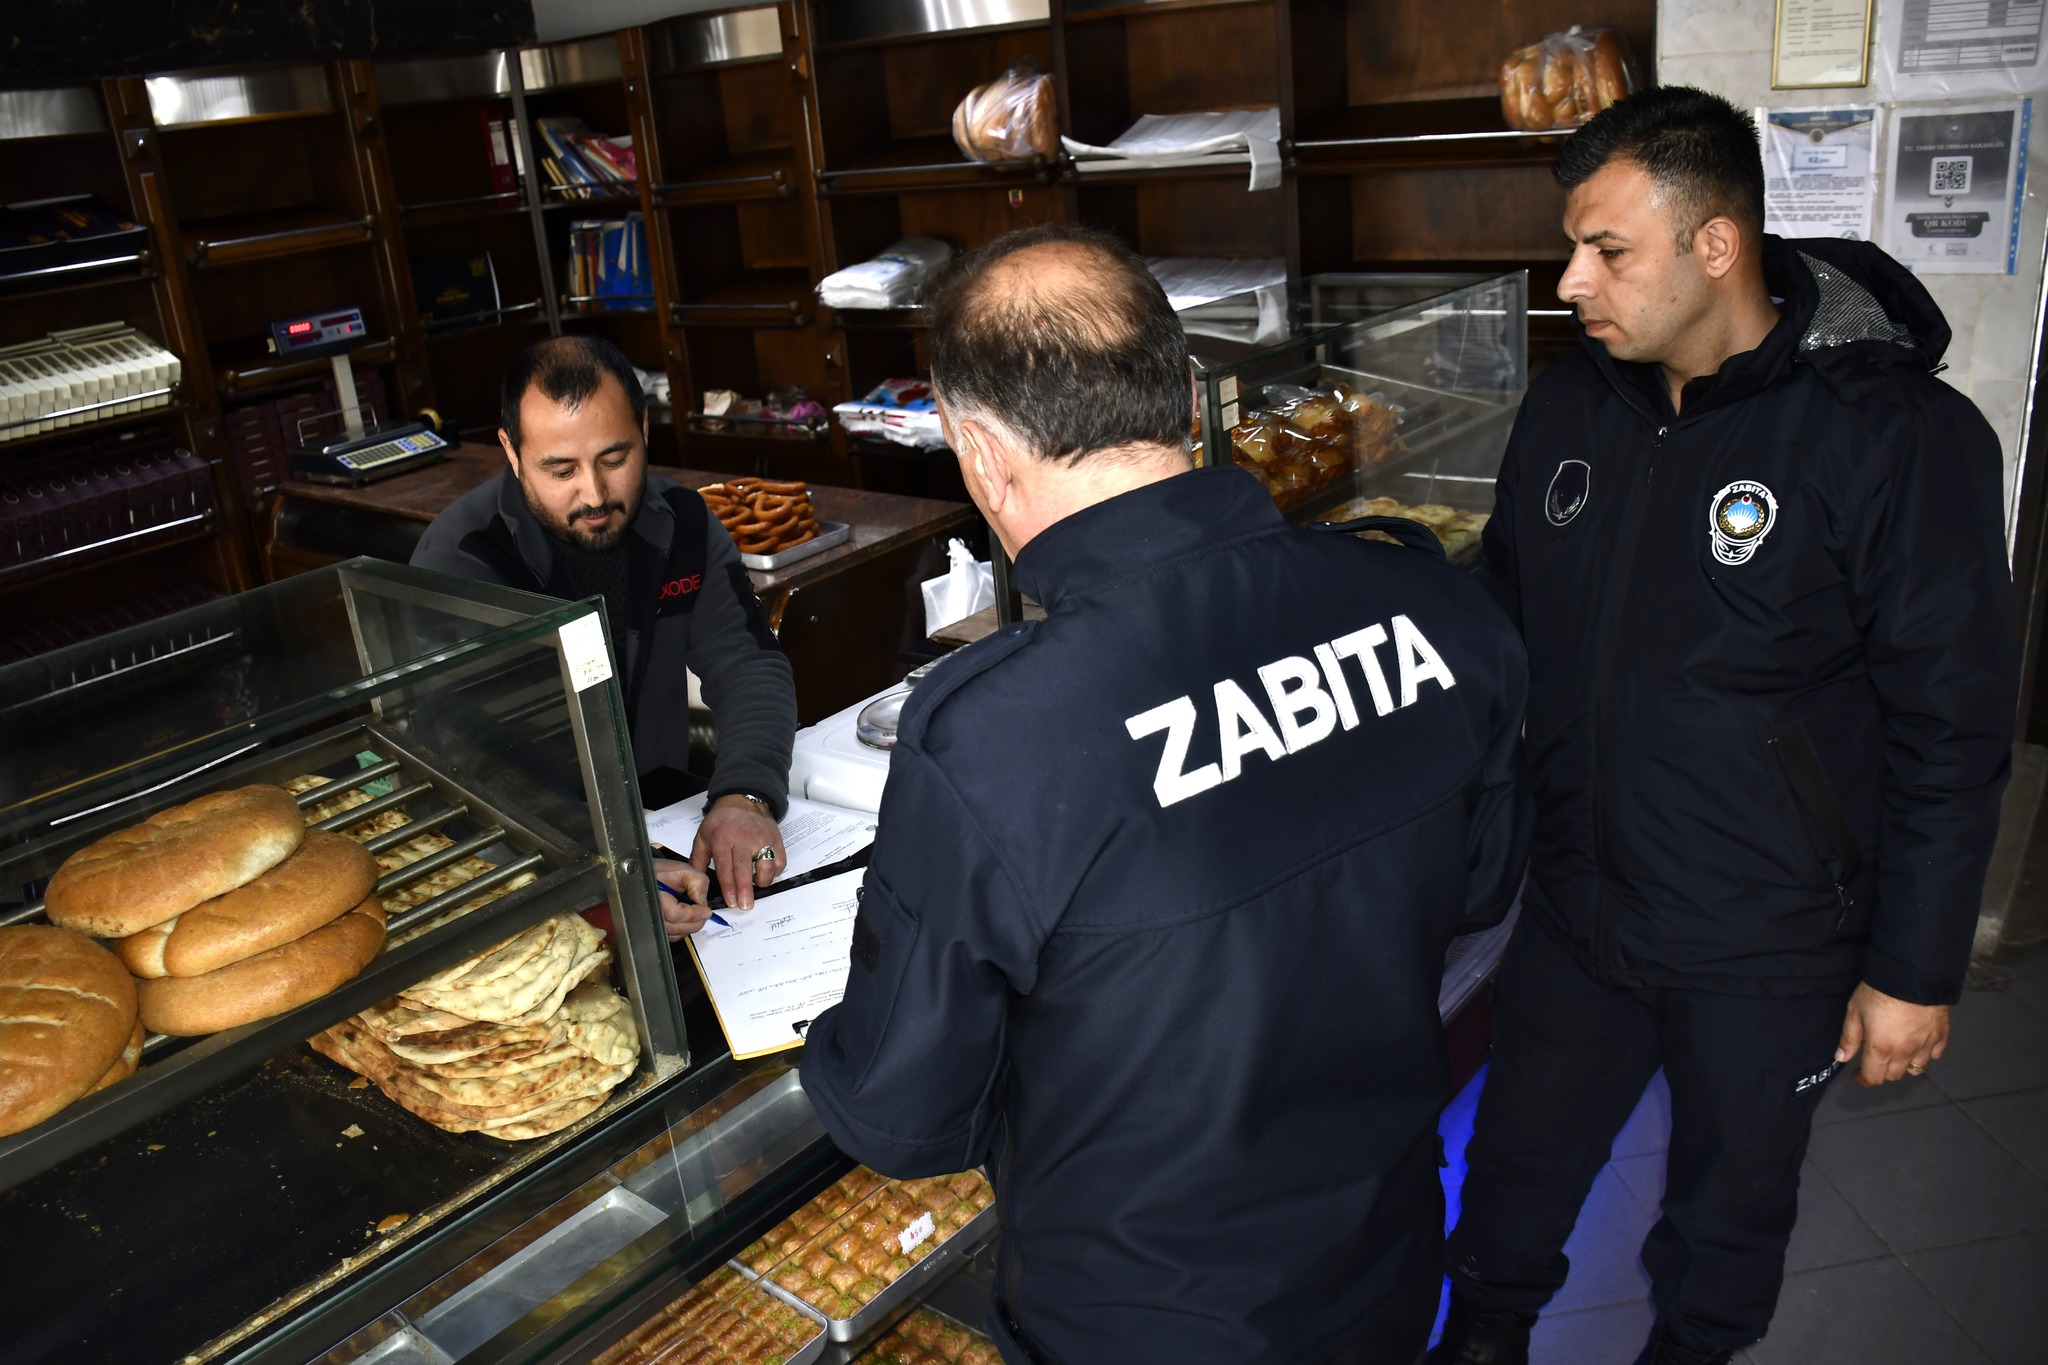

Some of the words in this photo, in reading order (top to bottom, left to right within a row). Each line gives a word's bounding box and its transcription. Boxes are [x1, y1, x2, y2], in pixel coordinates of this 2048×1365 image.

[1923, 219, 1939, 228] QR
[1732, 484, 1767, 499] ZABITA
[1125, 613, 1456, 808] ZABITA
[1795, 1060, 1840, 1093] ZABIT
